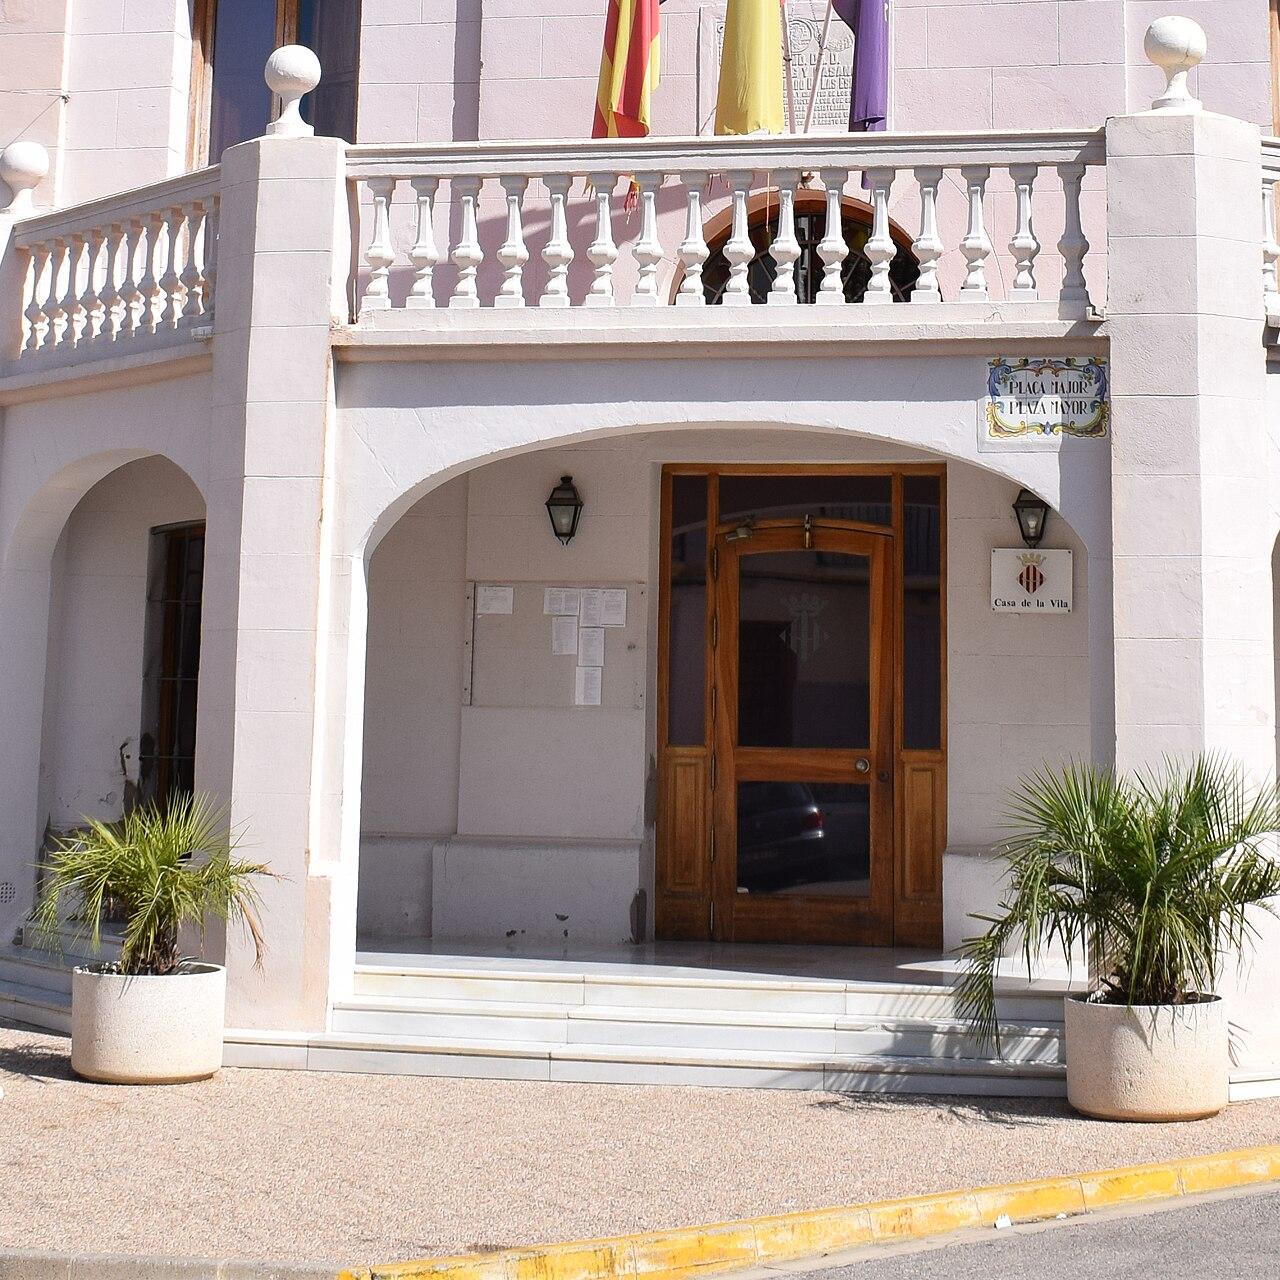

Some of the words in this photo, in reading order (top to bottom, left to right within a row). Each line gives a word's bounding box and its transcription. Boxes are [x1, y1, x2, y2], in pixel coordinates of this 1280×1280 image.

[1009, 380, 1046, 396] PLAÇA
[1050, 380, 1089, 395] MAJOR
[1009, 400, 1047, 415] PLAZA
[1050, 400, 1088, 415] MAYOR
[994, 598, 1016, 607] Casa
[1021, 599, 1032, 607] de
[1036, 599, 1045, 608] la
